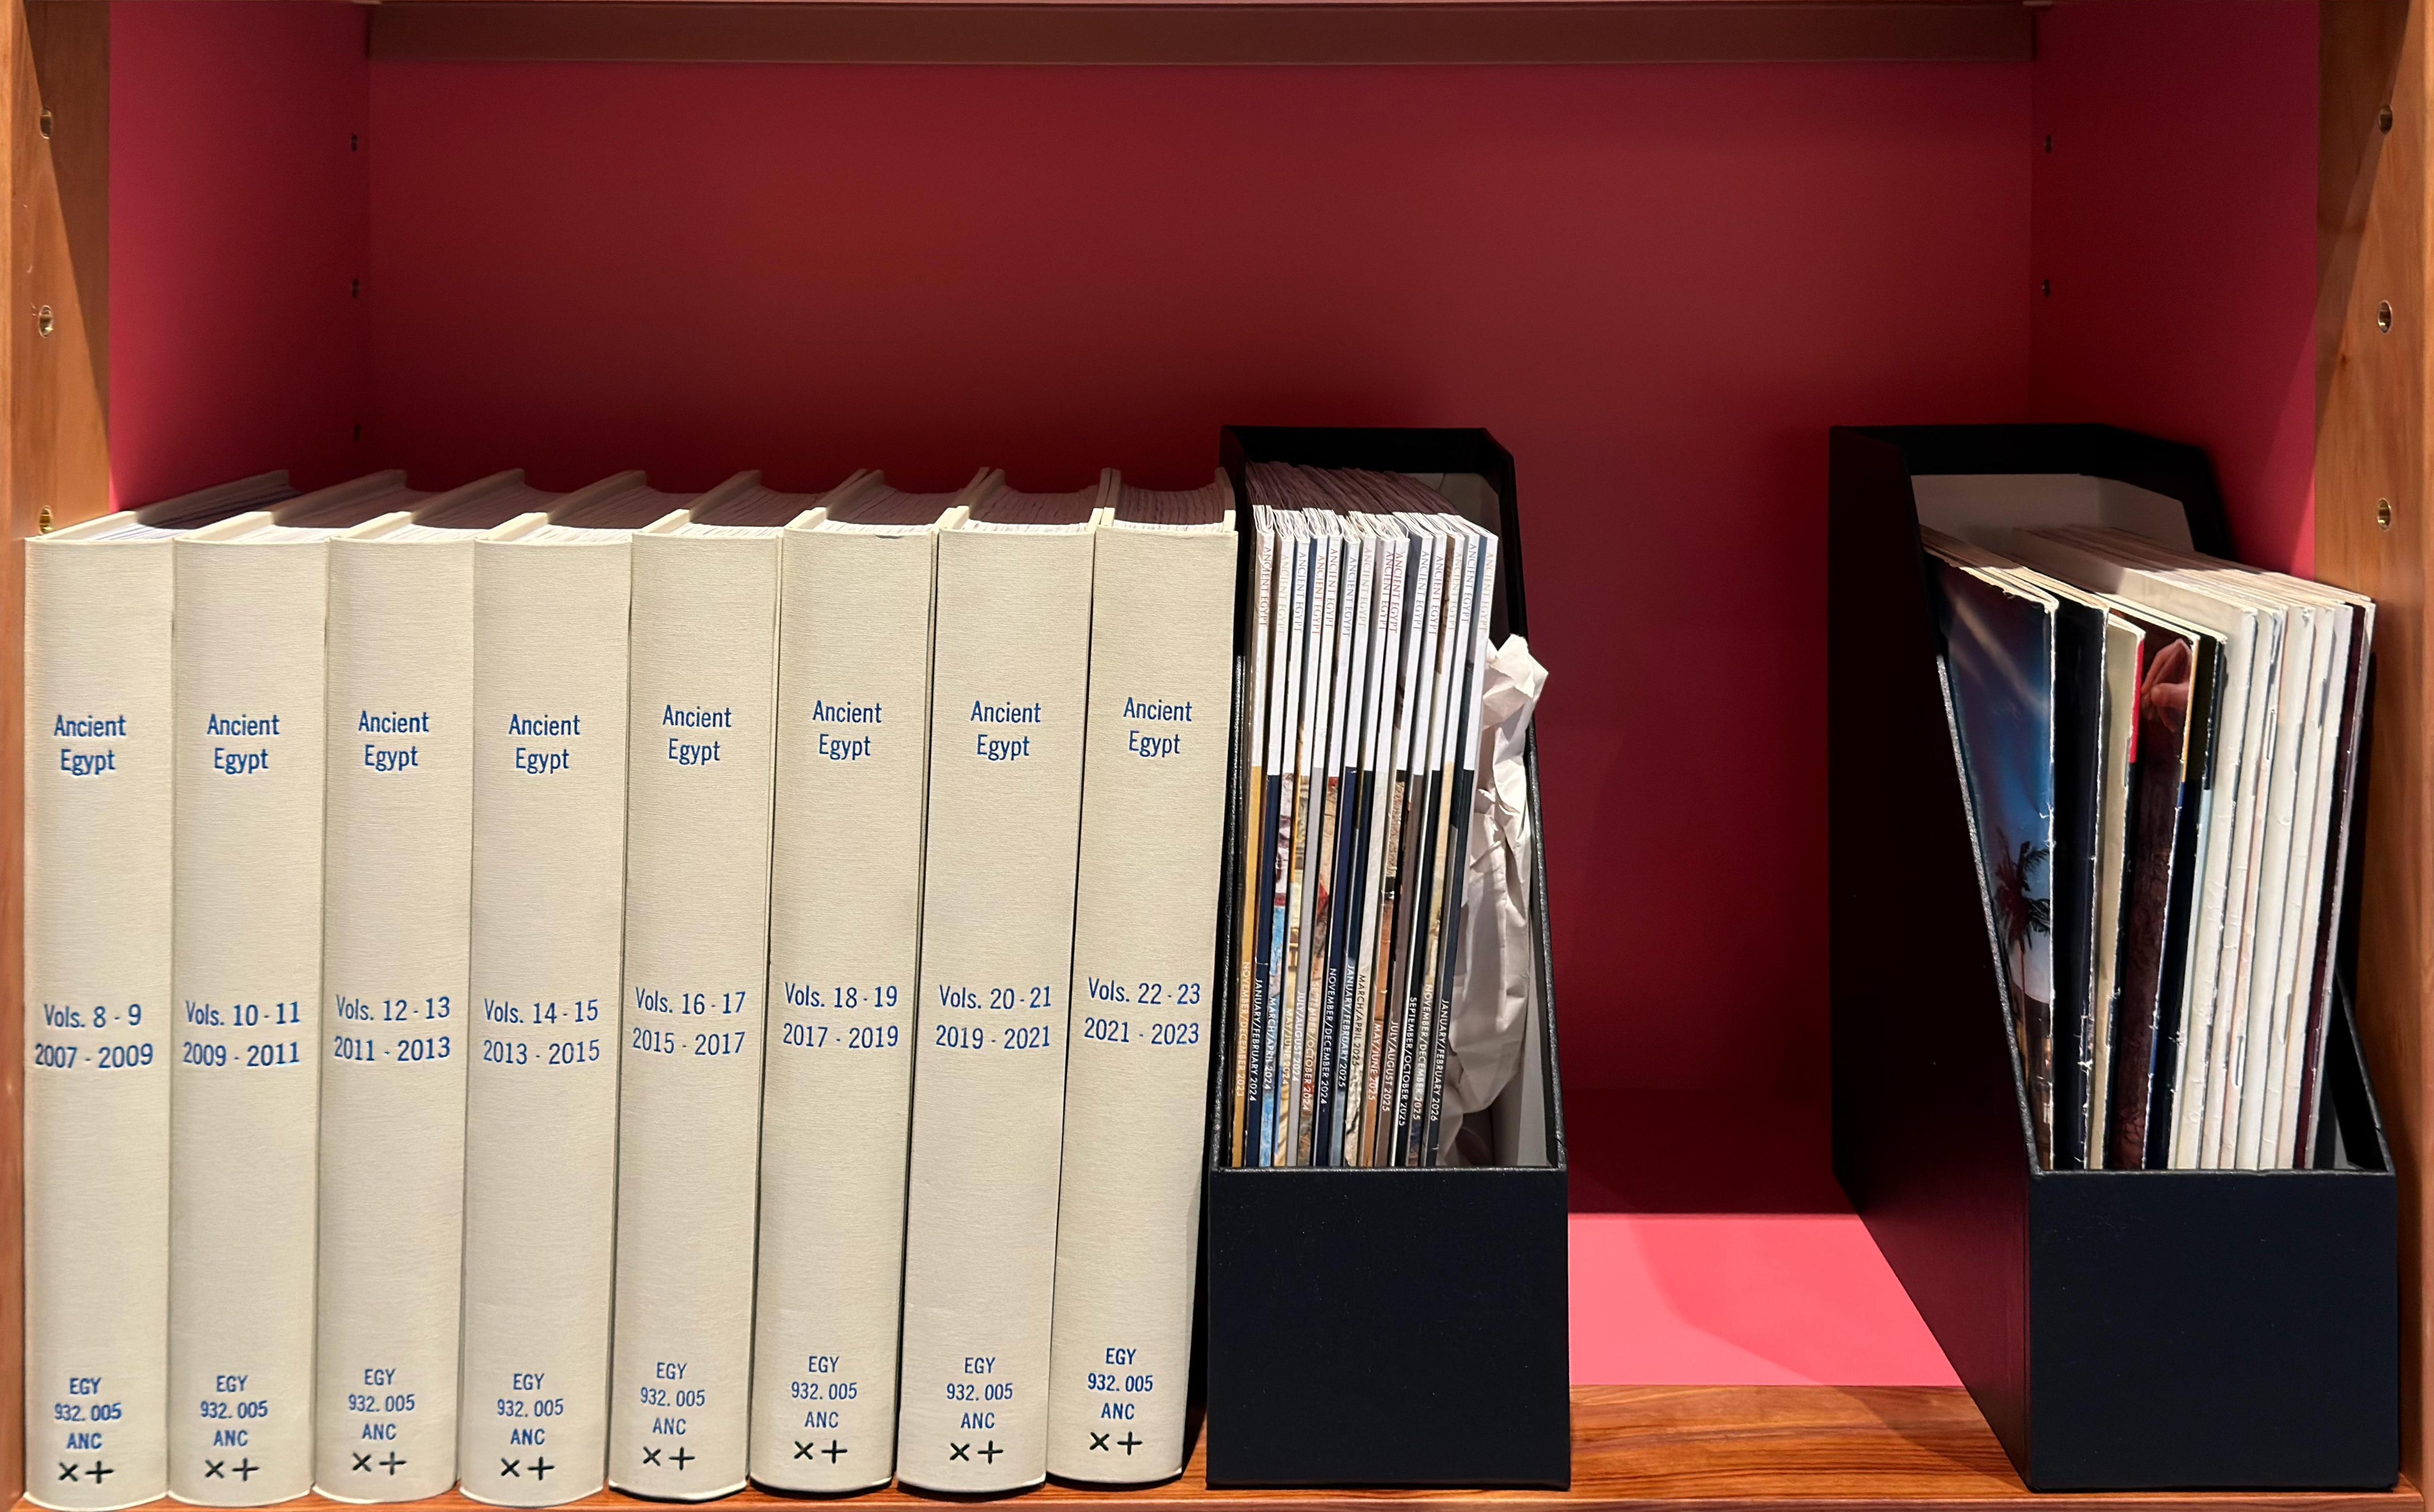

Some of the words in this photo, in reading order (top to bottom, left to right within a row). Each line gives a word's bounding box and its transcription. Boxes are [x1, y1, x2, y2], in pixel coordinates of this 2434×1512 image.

[1261, 547, 1271, 590] ANCIENT
[1279, 555, 1289, 602] ANCIENT
[1296, 552, 1306, 601] ANCIENT
[1315, 555, 1325, 602] ANCIENT
[1328, 549, 1338, 595] ANCIENT
[1346, 557, 1357, 602] ANCIENT
[1361, 547, 1373, 596] ANCIENT
[1383, 552, 1393, 596] ANCIENT
[1392, 552, 1403, 598] ANCIENT
[1417, 551, 1429, 597] ANCIENT
[1432, 556, 1444, 603] ANCIENT
[1451, 552, 1462, 602] ANCIENT
[1464, 544, 1477, 590] ANCIENT
[1482, 552, 1493, 602] ANCIENT
[1259, 597, 1268, 625] EGYPT
[1277, 604, 1286, 635] EGYPT
[1294, 602, 1304, 632] EGYPT
[1312, 605, 1322, 635] EGYPT
[1325, 598, 1335, 628] EGYPT
[1343, 606, 1352, 636] EGYPT
[1358, 597, 1368, 627] EGYPT
[1379, 601, 1389, 630] EGYPT
[1389, 602, 1400, 633] EGYPT
[1414, 601, 1424, 630] EGYPT
[1429, 605, 1440, 635] EGYPT
[1448, 602, 1457, 631] EGYPT
[1461, 593, 1472, 622] EGYPT
[1479, 602, 1489, 632] EGYPT
[358, 709, 431, 734] Ancient
[662, 704, 733, 728] Ancient
[811, 699, 883, 724] Ancient
[970, 700, 1042, 724] Ancient
[1122, 696, 1193, 722] Ancient
[53, 713, 128, 738] Ancient
[206, 712, 281, 736] Ancient
[508, 713, 581, 737] Ancient
[364, 743, 419, 772] Egypt
[668, 737, 721, 766] Egypt
[818, 732, 872, 761] Egypt
[976, 733, 1031, 762] Egypt
[1128, 729, 1181, 759] Egypt
[60, 748, 117, 777] Egypt
[213, 747, 270, 776] Egypt
[515, 746, 571, 775] Egypt
[635, 986, 674, 1014] Vols.
[681, 992, 706, 1015] 16
[722, 990, 746, 1015] 17
[784, 981, 826, 1008] Vols.
[833, 986, 858, 1010] 18
[874, 984, 898, 1008] 19
[938, 983, 982, 1010] Vols.
[989, 987, 1015, 1010] 20
[1029, 985, 1052, 1009] 21
[1088, 976, 1131, 1003] Vols.
[1137, 982, 1162, 1006] 22
[1176, 982, 1201, 1006] 23
[43, 1003, 87, 1029] Vols.
[92, 1005, 108, 1029] 8
[127, 1003, 143, 1027] 9
[184, 999, 226, 1027] Vols.
[232, 1003, 259, 1027] 10
[275, 1000, 301, 1026] 11
[335, 994, 375, 1022] Vols.
[383, 998, 408, 1022] 12
[425, 995, 451, 1020] 13
[483, 997, 525, 1024] Vols.
[532, 1001, 558, 1025] 14
[574, 998, 599, 1023] 15
[1237, 963, 1251, 1071] NOVEMBER/DECEMBER
[1340, 965, 1355, 1061] JANUARY/FEBRUARY
[1354, 975, 1366, 1039] MARCH/APRIL
[782, 1022, 829, 1048] 2017
[848, 1024, 899, 1050] 2019
[935, 1024, 984, 1050] 2019
[1003, 1025, 1050, 1050] 2021
[1083, 1016, 1130, 1043] 2021
[1150, 1022, 1200, 1046] 2023
[1251, 979, 1262, 1075] JANUARY/FEBRUARY
[1265, 997, 1277, 1063] MARCH/APRIL
[1283, 1008, 1293, 1059] MAY/JUNE
[1294, 991, 1305, 1055] JULY/AUGUST
[1322, 968, 1337, 1078] NOVEMBER/DECEMBER
[333, 1035, 376, 1062] 2011
[396, 1035, 451, 1062] 2013
[483, 1039, 528, 1066] 2013
[548, 1038, 600, 1066] 2015
[632, 1026, 675, 1054] 2015
[694, 1031, 746, 1056] 2017
[1370, 1023, 1381, 1074] MAY/JUNE
[1401, 997, 1417, 1099] SEPTEMBER/OCTOBER
[1416, 984, 1432, 1093] NOVEMBER/DECEMBER
[1433, 999, 1449, 1095] JANUARY/FEBRUARY
[34, 1042, 79, 1069] 2007
[97, 1042, 154, 1069] 2009
[182, 1040, 227, 1067] 2009
[246, 1040, 301, 1067] 2011
[1385, 1021, 1398, 1086] JULY/AUGUST
[1264, 1066, 1273, 1090] 2024
[1338, 1064, 1347, 1087] 2025
[1368, 1077, 1377, 1100] 2025
[1302, 1086, 1311, 1110] 2024
[1382, 1088, 1391, 1111] 2025
[1413, 1097, 1422, 1120] 2025
[1431, 1098, 1440, 1121] 2026
[1399, 1102, 1407, 1126] 2025
[656, 1361, 688, 1381] EGY
[808, 1355, 840, 1374] EGY
[964, 1356, 996, 1375] EGY
[1105, 1347, 1137, 1366] EGY
[69, 1376, 103, 1396] EGY
[215, 1374, 249, 1393] EGY
[363, 1368, 397, 1387] EGY
[512, 1372, 546, 1391] EGY
[804, 1410, 840, 1429] ANC
[960, 1411, 996, 1430] ANC
[1100, 1401, 1136, 1421] ANC
[66, 1431, 103, 1450] ANC
[212, 1428, 249, 1448] ANC
[361, 1422, 397, 1441] ANC
[510, 1428, 546, 1446] ANC
[651, 1417, 687, 1436] ANC
